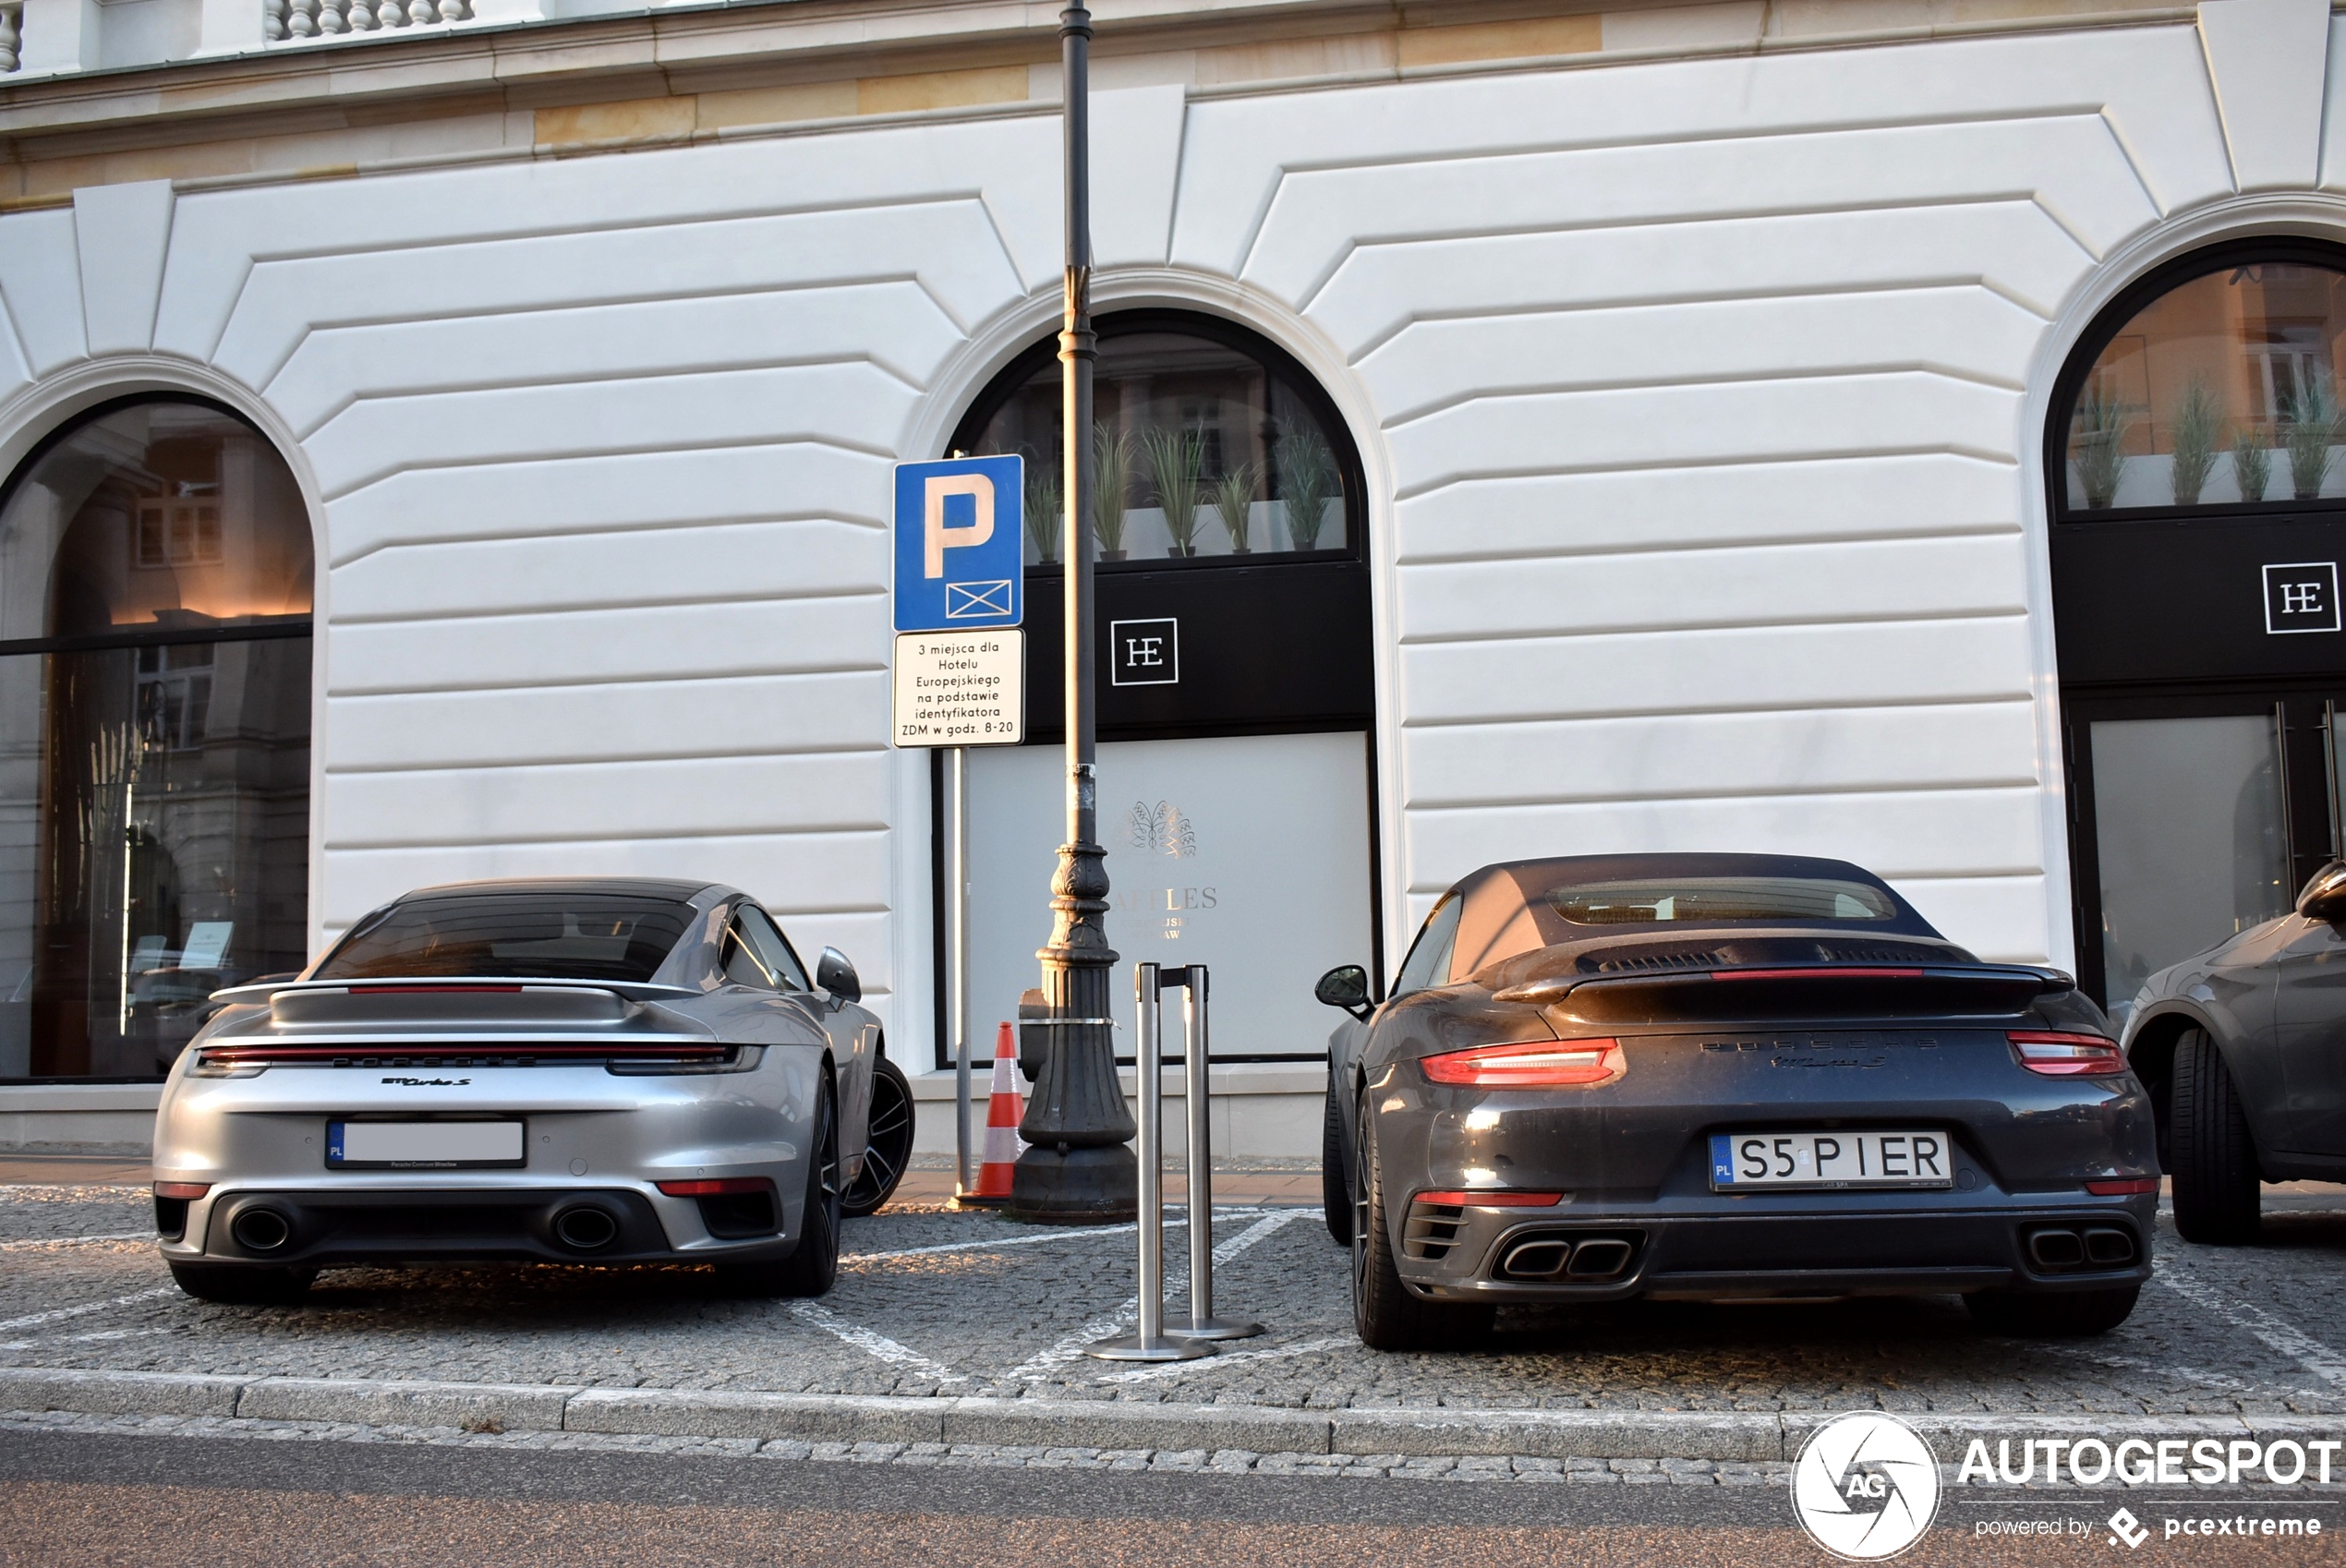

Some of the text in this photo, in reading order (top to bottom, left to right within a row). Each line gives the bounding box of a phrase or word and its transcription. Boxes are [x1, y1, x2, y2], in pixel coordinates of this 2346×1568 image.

[925, 474, 995, 579] P
[2279, 582, 2323, 614] HE
[919, 643, 998, 656] 3 miejsca dla
[1126, 637, 1163, 667] HE
[939, 659, 977, 669] Hotelu
[917, 675, 999, 688] Europejskiego
[937, 691, 998, 705] podstawie
[915, 707, 1000, 721] identyfikatora
[902, 725, 928, 735] ZDM
[948, 724, 978, 737] godz.
[986, 722, 1012, 732] 8-20
[333, 1057, 536, 1067] PORSCHE
[331, 1147, 343, 1156] PL
[1716, 1165, 1731, 1176] PL
